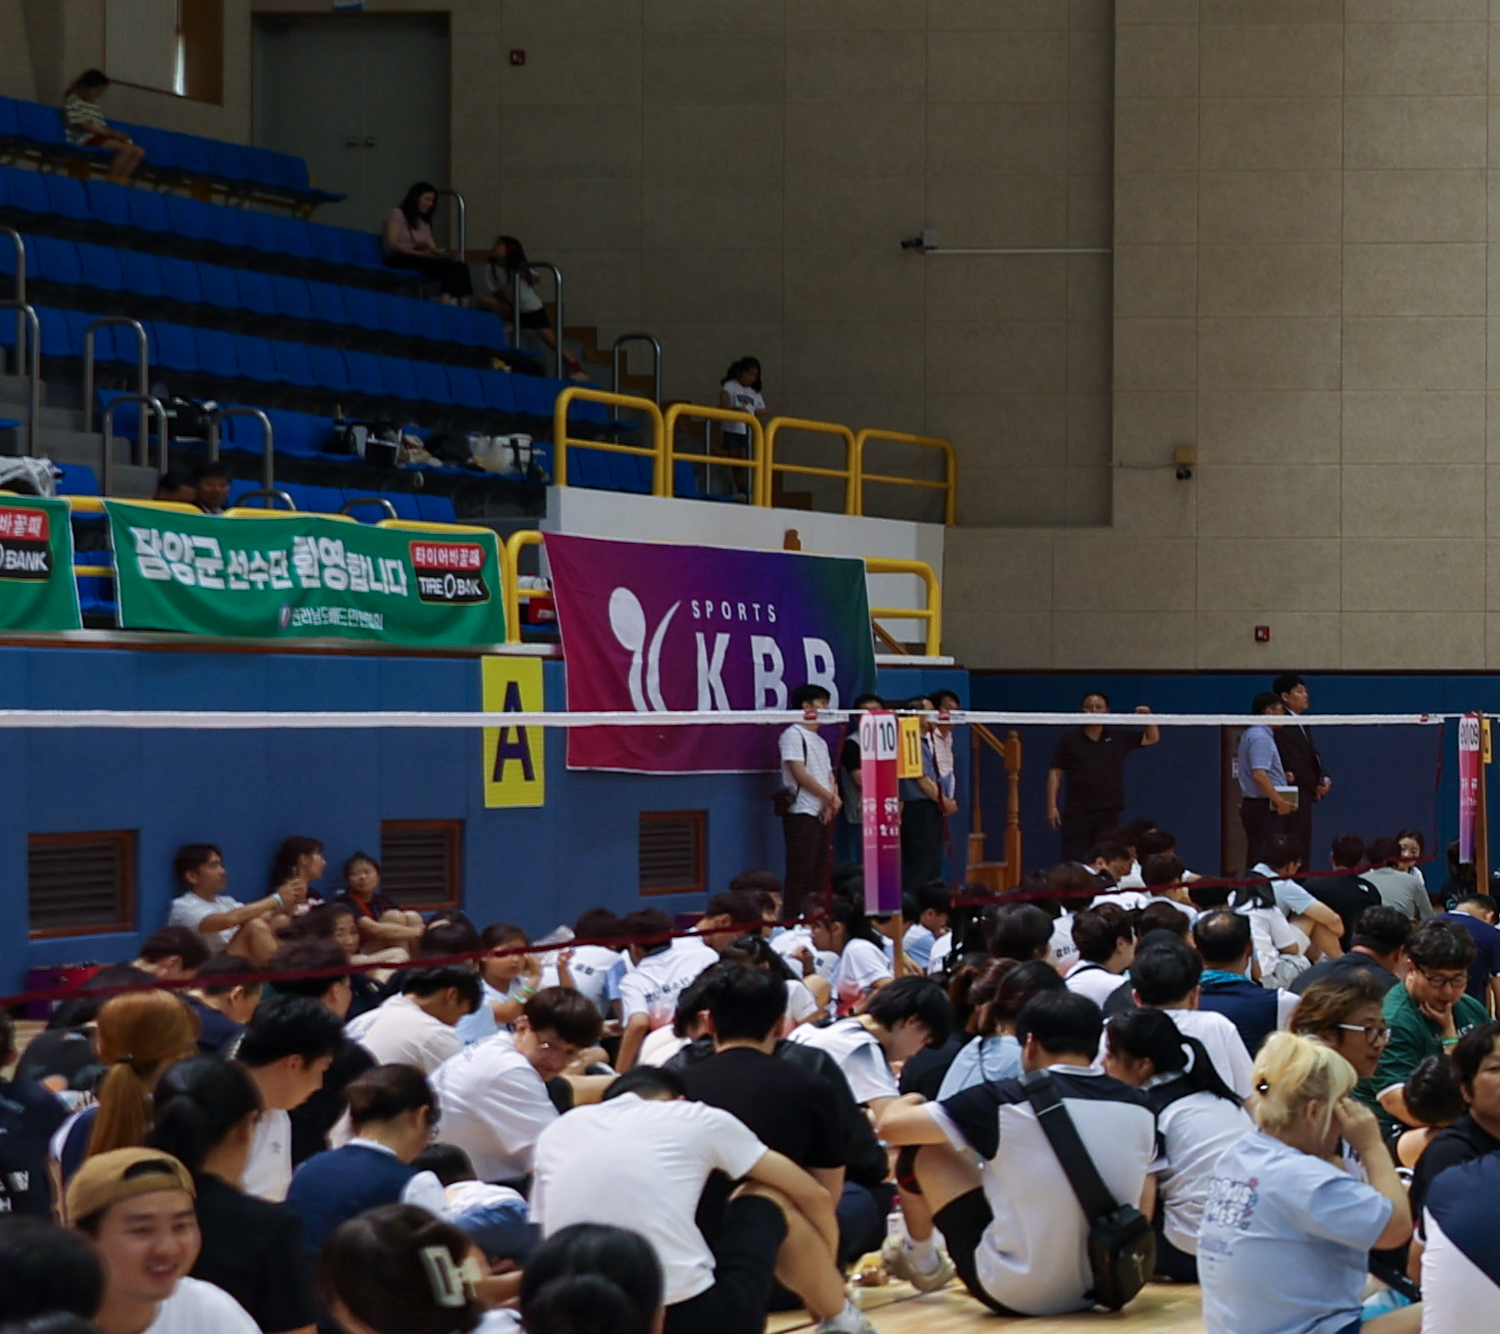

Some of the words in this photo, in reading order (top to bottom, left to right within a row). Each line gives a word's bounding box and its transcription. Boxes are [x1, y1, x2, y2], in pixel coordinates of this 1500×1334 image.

[226, 548, 294, 590] 선수단
[292, 535, 409, 597] 환영합니다
[691, 598, 777, 624] SPORTS
[492, 680, 536, 783] A
[879, 716, 895, 747] 10
[905, 729, 918, 759] 11
